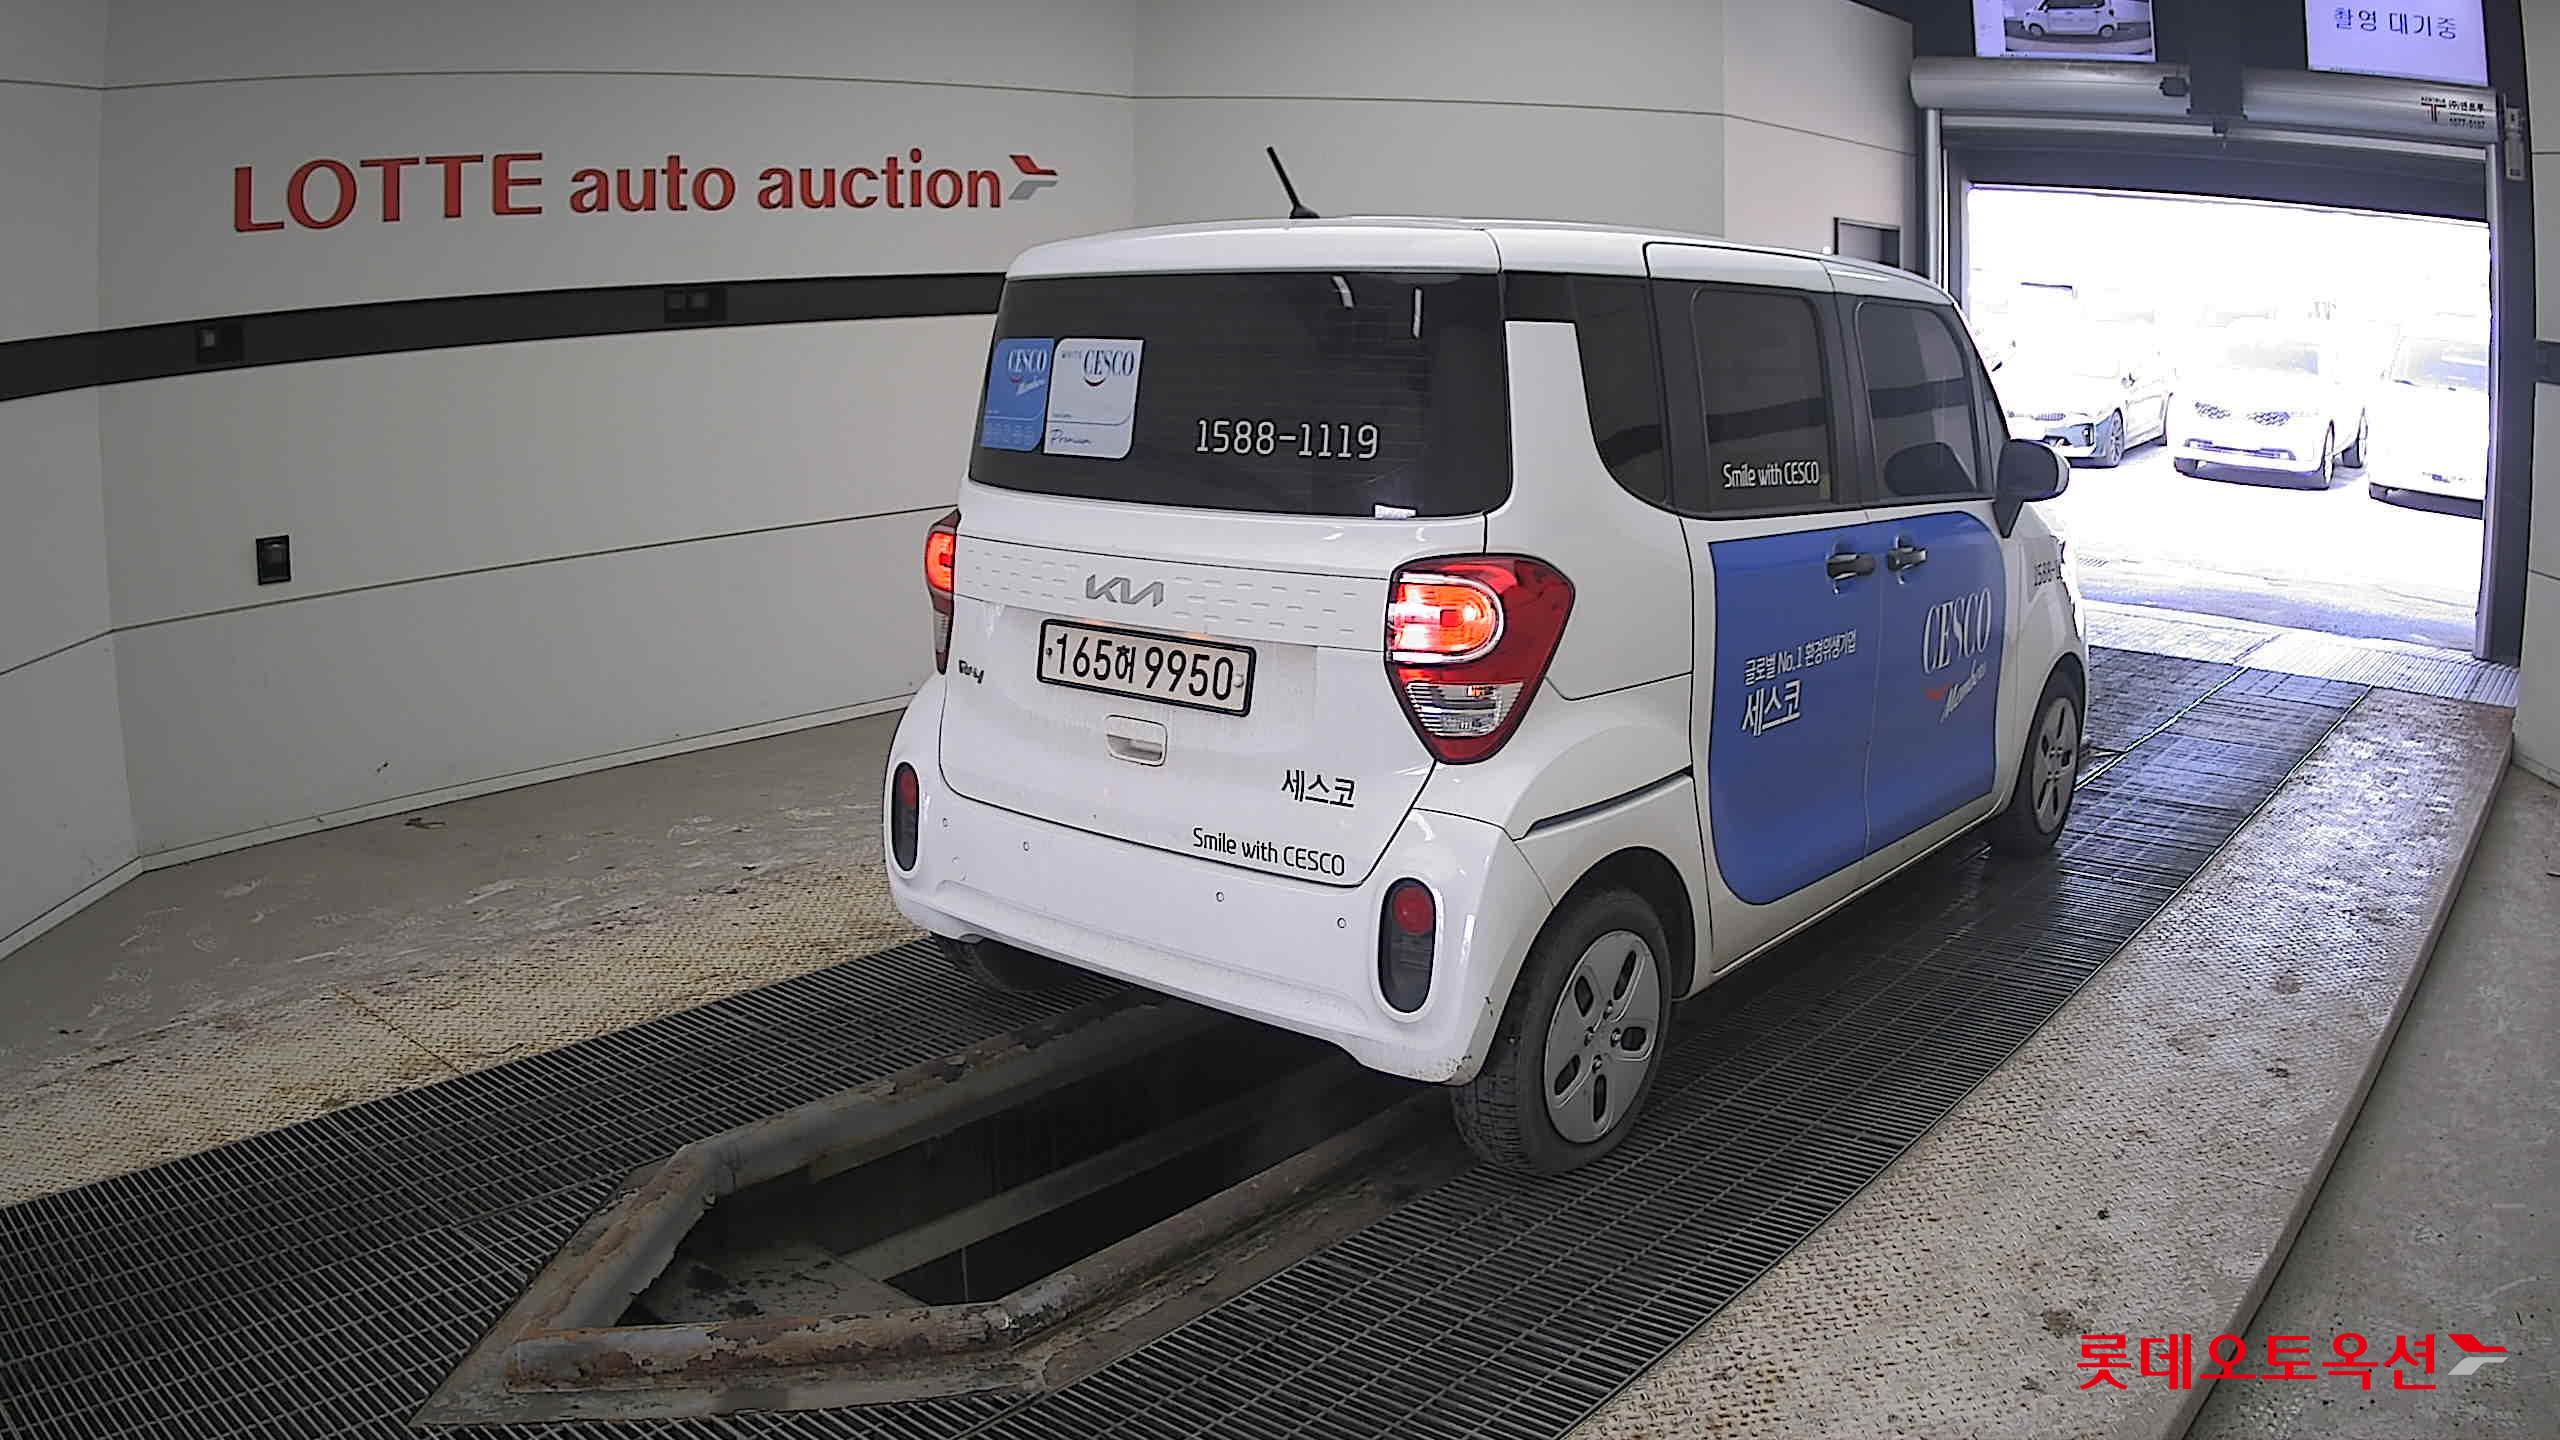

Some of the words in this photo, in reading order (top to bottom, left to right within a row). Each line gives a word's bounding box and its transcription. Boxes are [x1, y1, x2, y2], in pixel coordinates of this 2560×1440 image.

[2389, 12, 2457, 40] 대기중
[234, 152, 543, 233] LOTTE
[569, 154, 737, 213] auto
[757, 147, 1001, 209] auction
[1007, 348, 1048, 373] CESCO
[1083, 350, 1135, 376] CESCO
[1196, 419, 1379, 459] 1588-1119
[1723, 463, 1756, 489] Smile
[1757, 463, 1783, 486] with
[1784, 461, 1820, 485] CESCO
[1923, 587, 1992, 675] CESCO
[1744, 652, 1777, 686] 글로벌
[1741, 679, 1801, 737] 세스코
[1281, 769, 1355, 808] 세스코
[1192, 827, 1236, 855] Smile
[1241, 840, 1278, 864] with
[1283, 846, 1345, 877] CESCO
